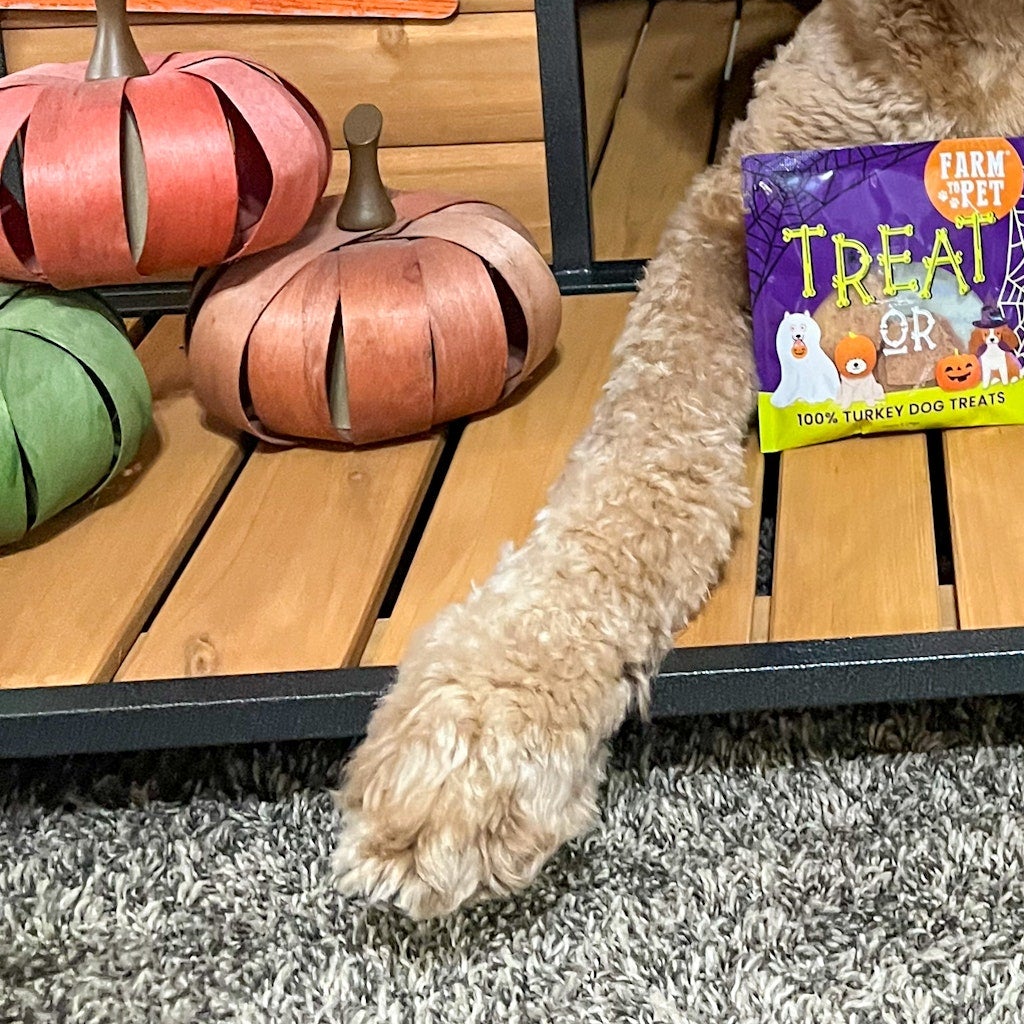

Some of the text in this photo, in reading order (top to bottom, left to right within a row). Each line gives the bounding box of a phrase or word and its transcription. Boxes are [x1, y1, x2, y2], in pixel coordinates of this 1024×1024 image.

[939, 150, 1006, 180] FARM
[946, 179, 1005, 209] TO PET
[782, 211, 997, 308] TREAT
[879, 306, 936, 357] OR
[797, 391, 1006, 427] 100% TURKEY DOG TREATS
